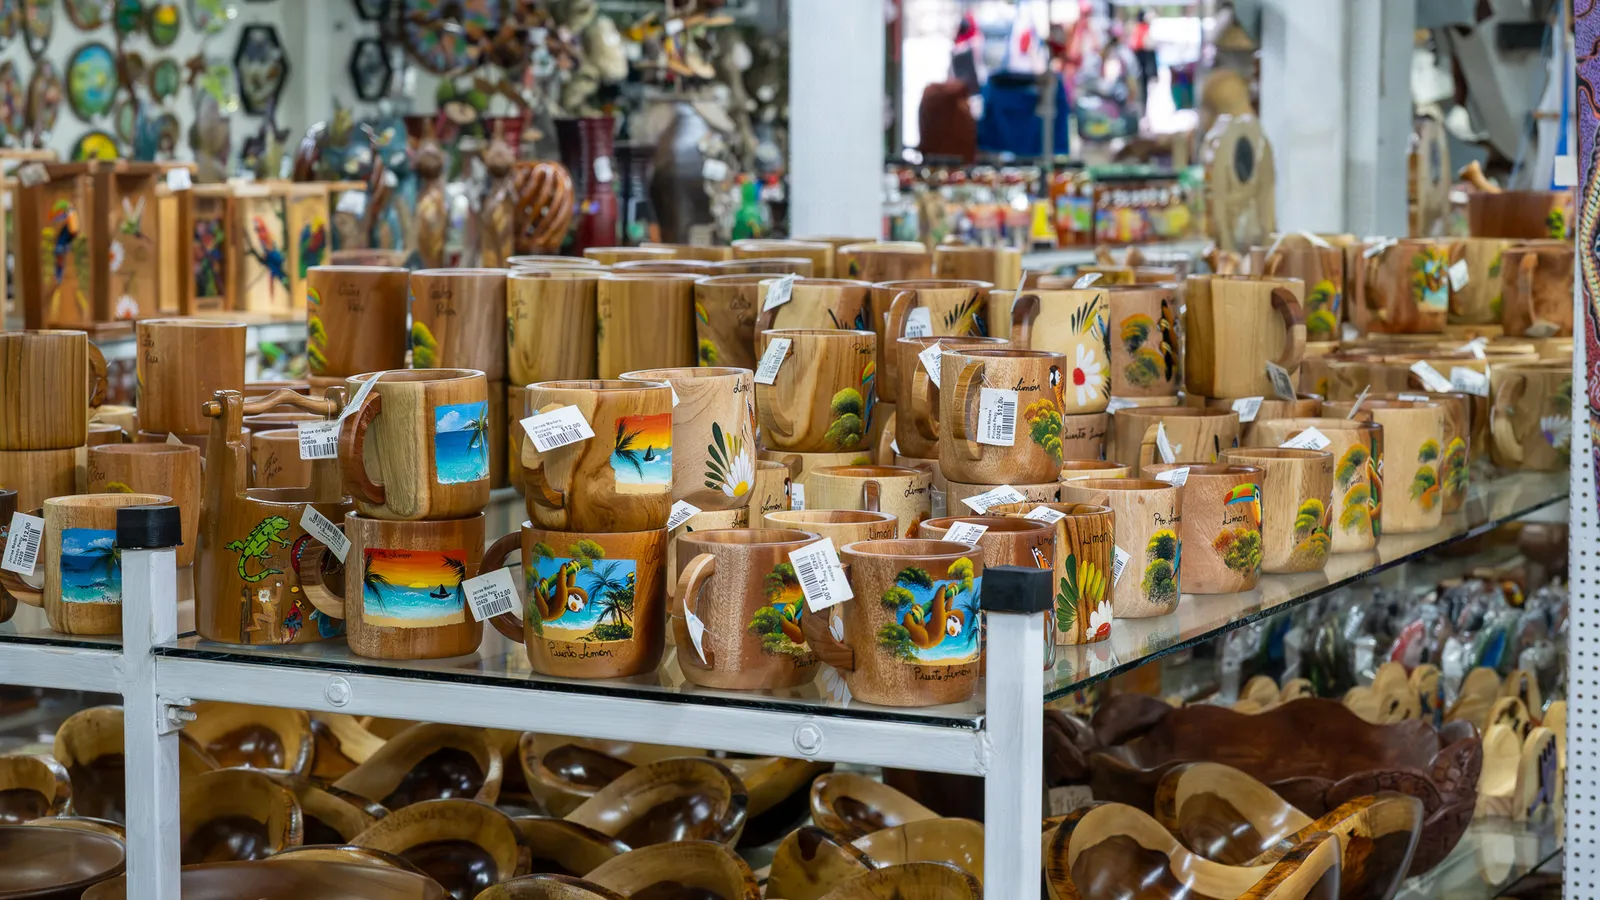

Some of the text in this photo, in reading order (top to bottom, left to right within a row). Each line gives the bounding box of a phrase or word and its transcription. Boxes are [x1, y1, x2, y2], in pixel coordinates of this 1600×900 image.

[1012, 377, 1042, 391] Limón
[560, 422, 582, 432] $12.00
[1222, 509, 1250, 525] Limón
[22, 522, 32, 542] $12.00
[494, 588, 511, 600] $12.00
[819, 579, 832, 600] $12.00
[548, 641, 613, 659] Puerto Limón
[913, 666, 942, 681] Puerto
